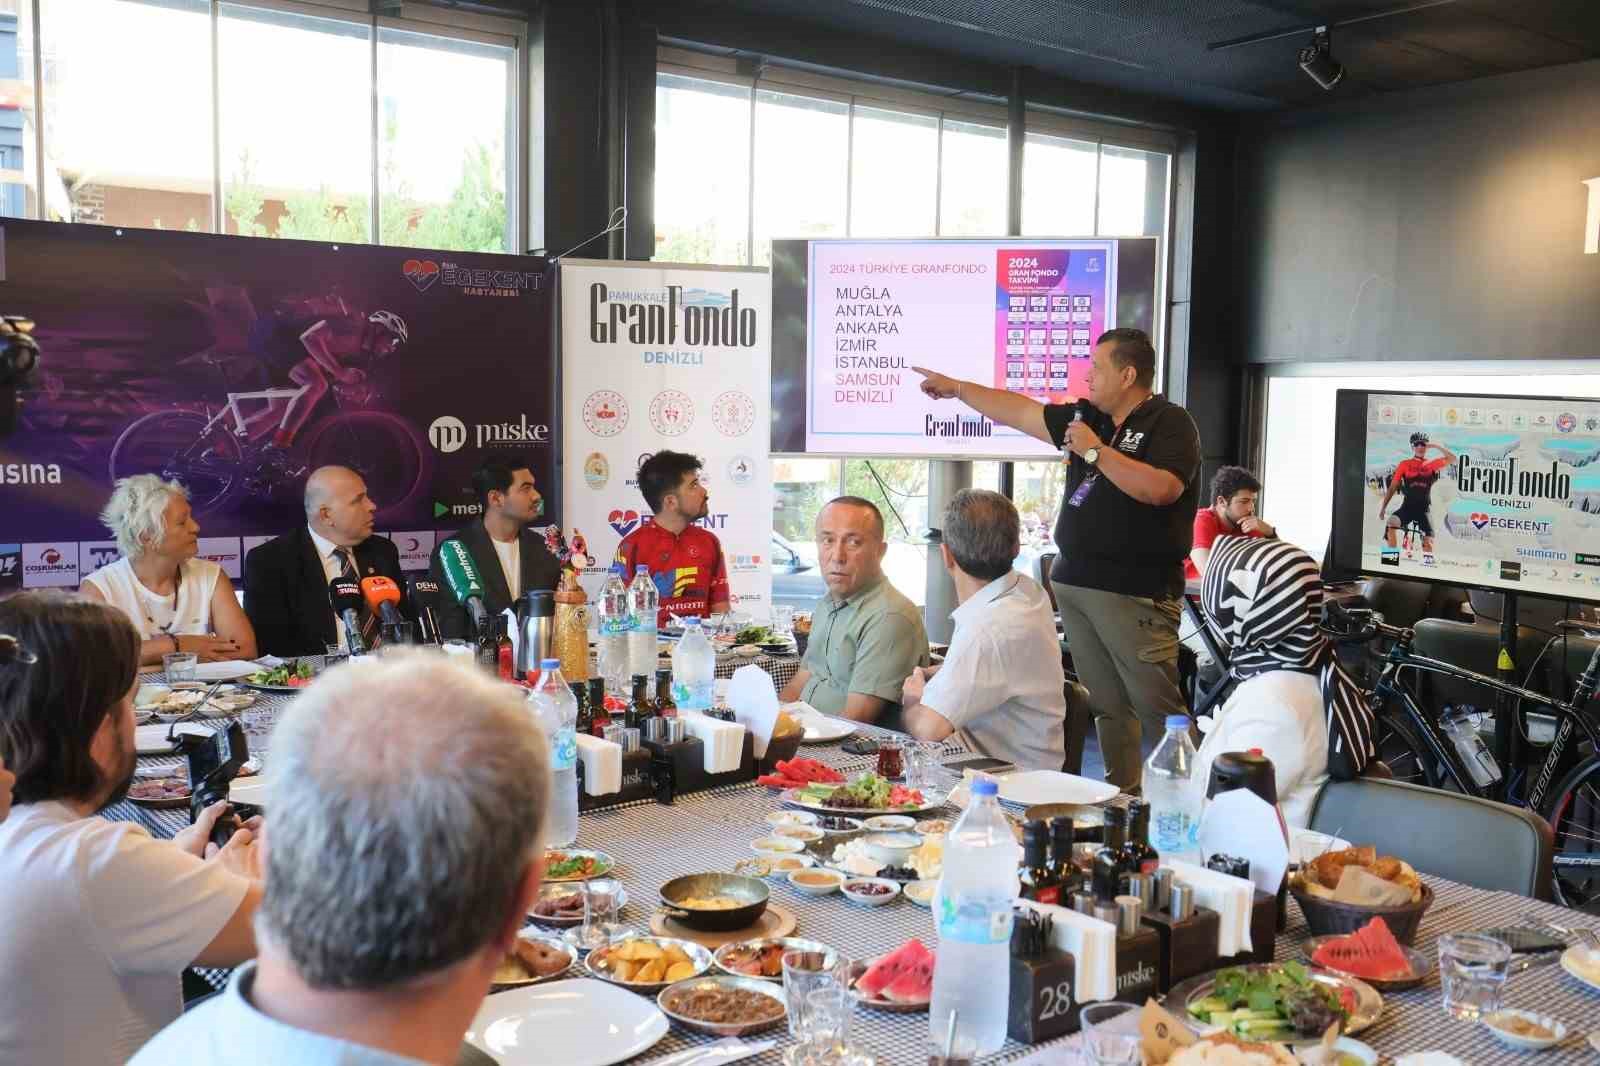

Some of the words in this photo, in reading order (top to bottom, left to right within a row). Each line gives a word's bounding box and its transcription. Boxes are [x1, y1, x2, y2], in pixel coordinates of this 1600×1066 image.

[829, 263, 855, 274] 2024
[859, 261, 909, 274] TÜRKİYE
[911, 263, 988, 274] GRANFONDO
[1008, 258, 1039, 268] 2024
[441, 267, 543, 289] EGEKENT
[836, 285, 891, 300] MUĞLA
[835, 304, 903, 317] ANTALYA
[835, 322, 899, 335] ANKARA
[835, 336, 877, 352] İZMİR
[835, 354, 909, 369] İSTANBUL
[835, 373, 900, 386] SAMSUN
[835, 388, 894, 403] DENİZLİ
[475, 413, 549, 449] miske
[1490, 517, 1550, 533] EGEKENT
[1039, 981, 1071, 1021] 28
